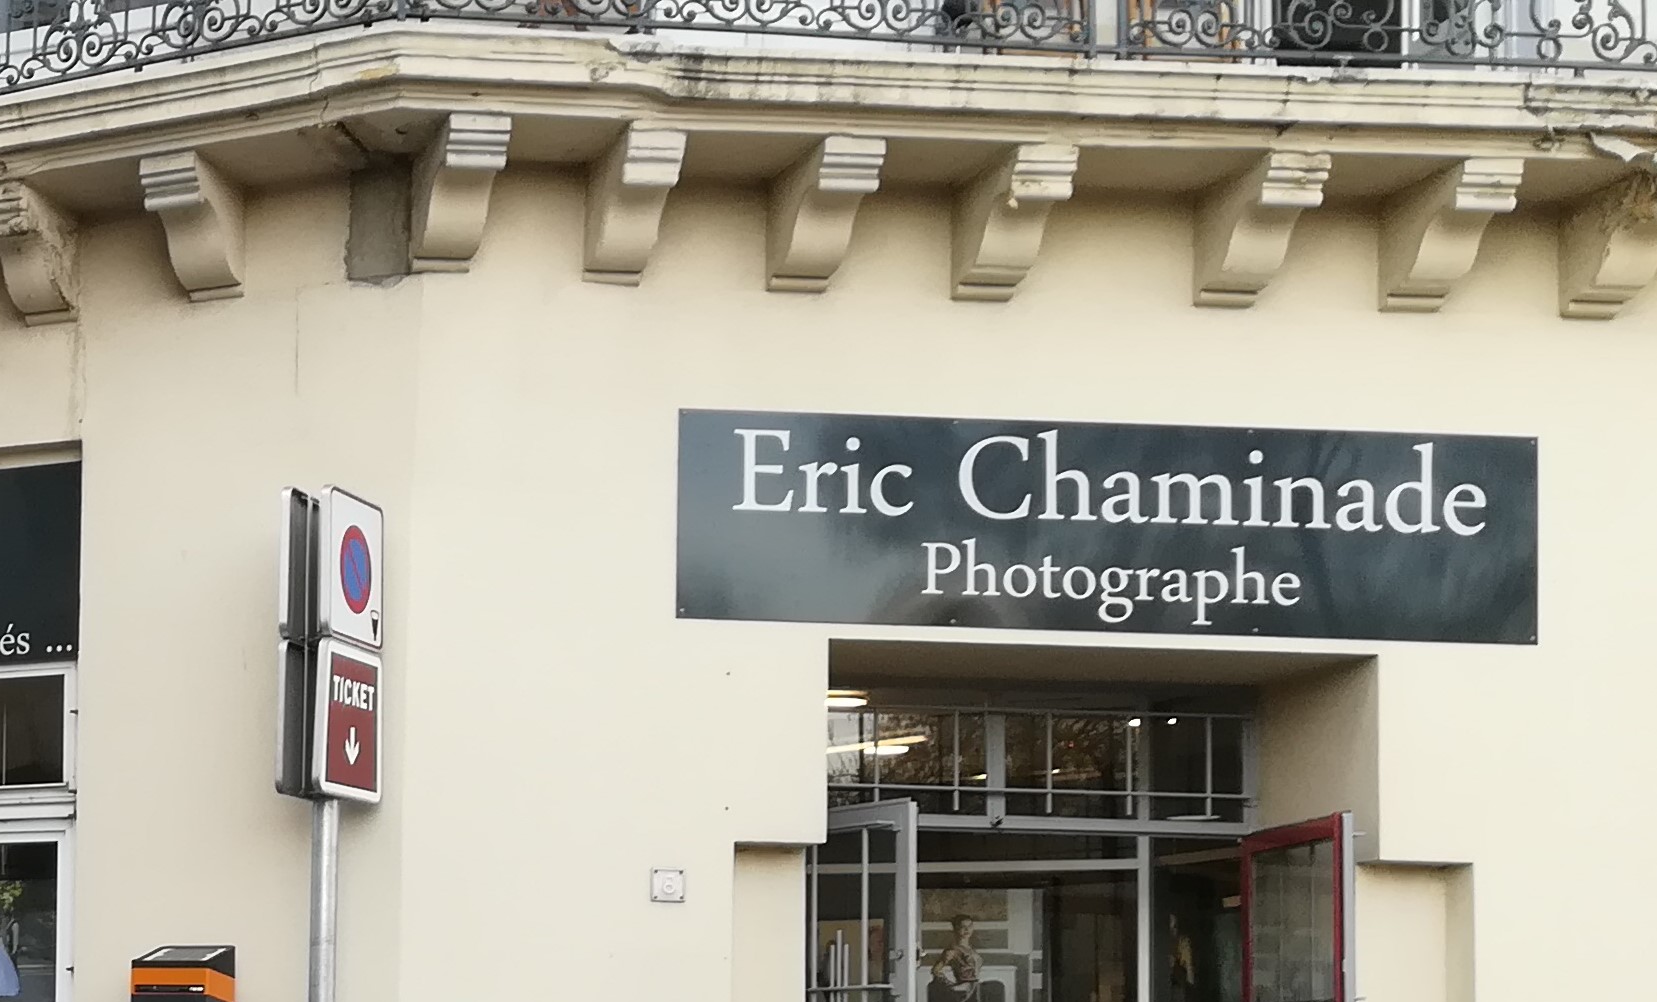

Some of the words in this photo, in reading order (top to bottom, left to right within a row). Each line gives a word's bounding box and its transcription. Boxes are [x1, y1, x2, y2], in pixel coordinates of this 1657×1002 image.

[732, 429, 914, 517] Eric
[959, 430, 1487, 537] Chaminade
[921, 538, 1301, 626] Photographe
[332, 674, 375, 712] TICKET
